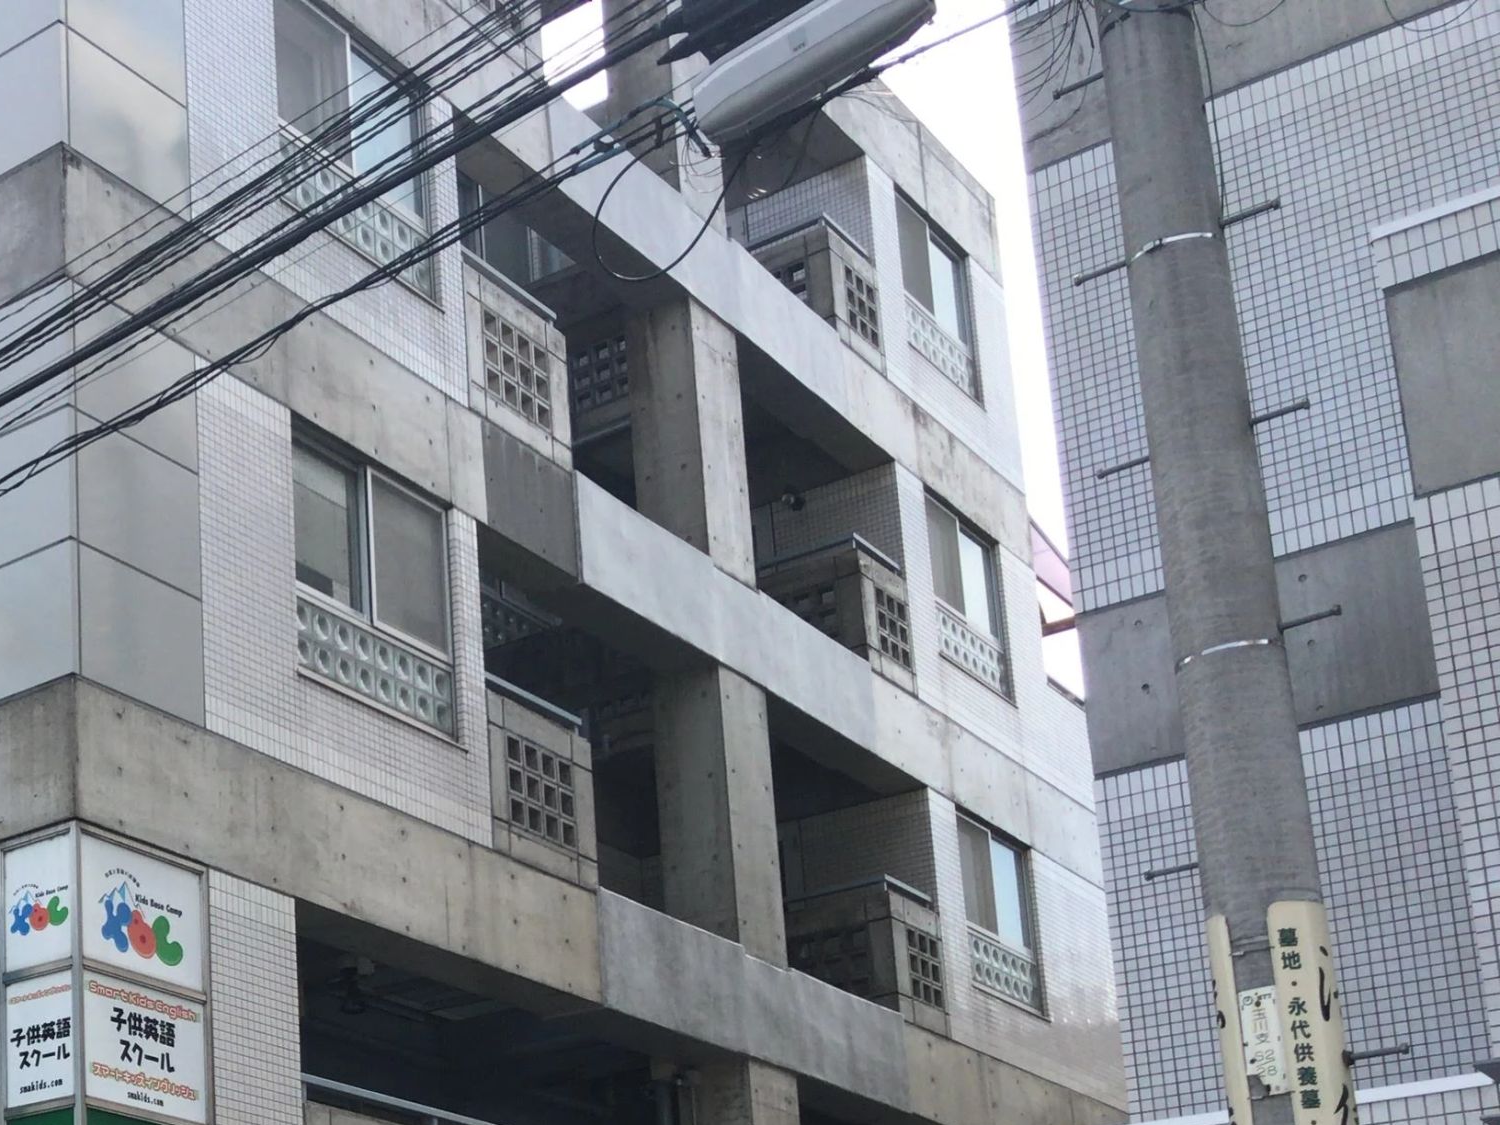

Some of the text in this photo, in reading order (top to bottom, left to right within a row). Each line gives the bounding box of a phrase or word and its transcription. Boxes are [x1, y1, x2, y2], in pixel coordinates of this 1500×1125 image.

[135, 893, 149, 906] Kids
[88, 980, 130, 1002] Smart
[129, 989, 154, 1009] Kids
[155, 1001, 197, 1022] English
[10, 1016, 71, 1047] 子供英語
[110, 1006, 176, 1048] 子供英語
[19, 1043, 70, 1069] スクール
[119, 1039, 176, 1072] スクール
[19, 1077, 63, 1094] smakids.com
